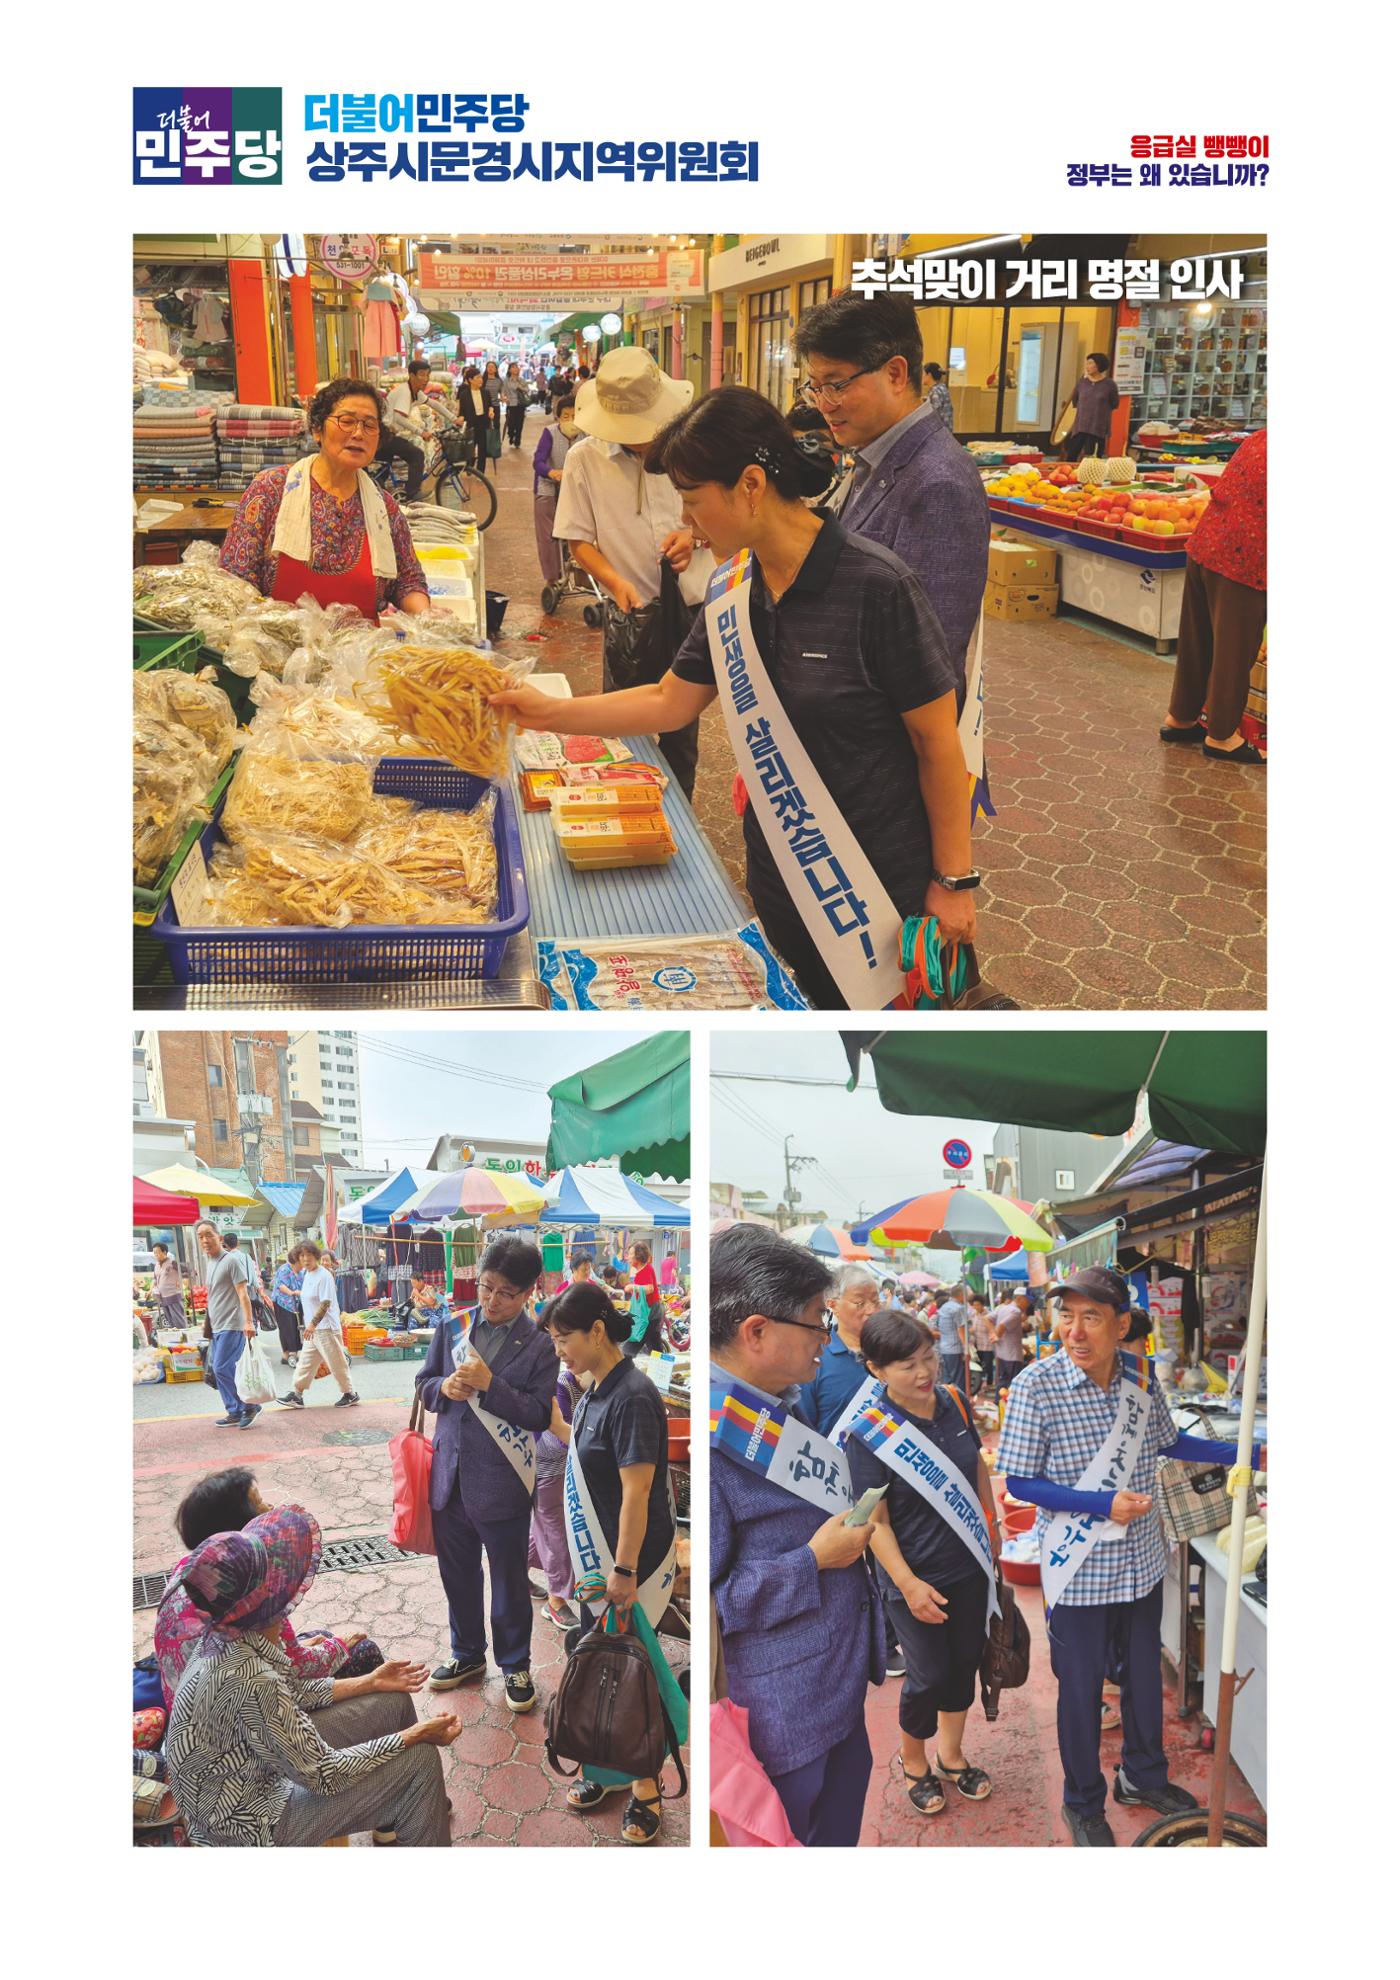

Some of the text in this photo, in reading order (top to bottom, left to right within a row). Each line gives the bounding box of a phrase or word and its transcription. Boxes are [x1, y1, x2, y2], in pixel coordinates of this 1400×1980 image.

[717, 604, 759, 716] 민생을
[744, 716, 877, 970] 살리겠습니다!
[745, 1407, 771, 1462] 더불어민주당
[1120, 1394, 1145, 1440] 함께
[789, 1440, 841, 1497] 함께
[893, 1437, 949, 1492] 민생을
